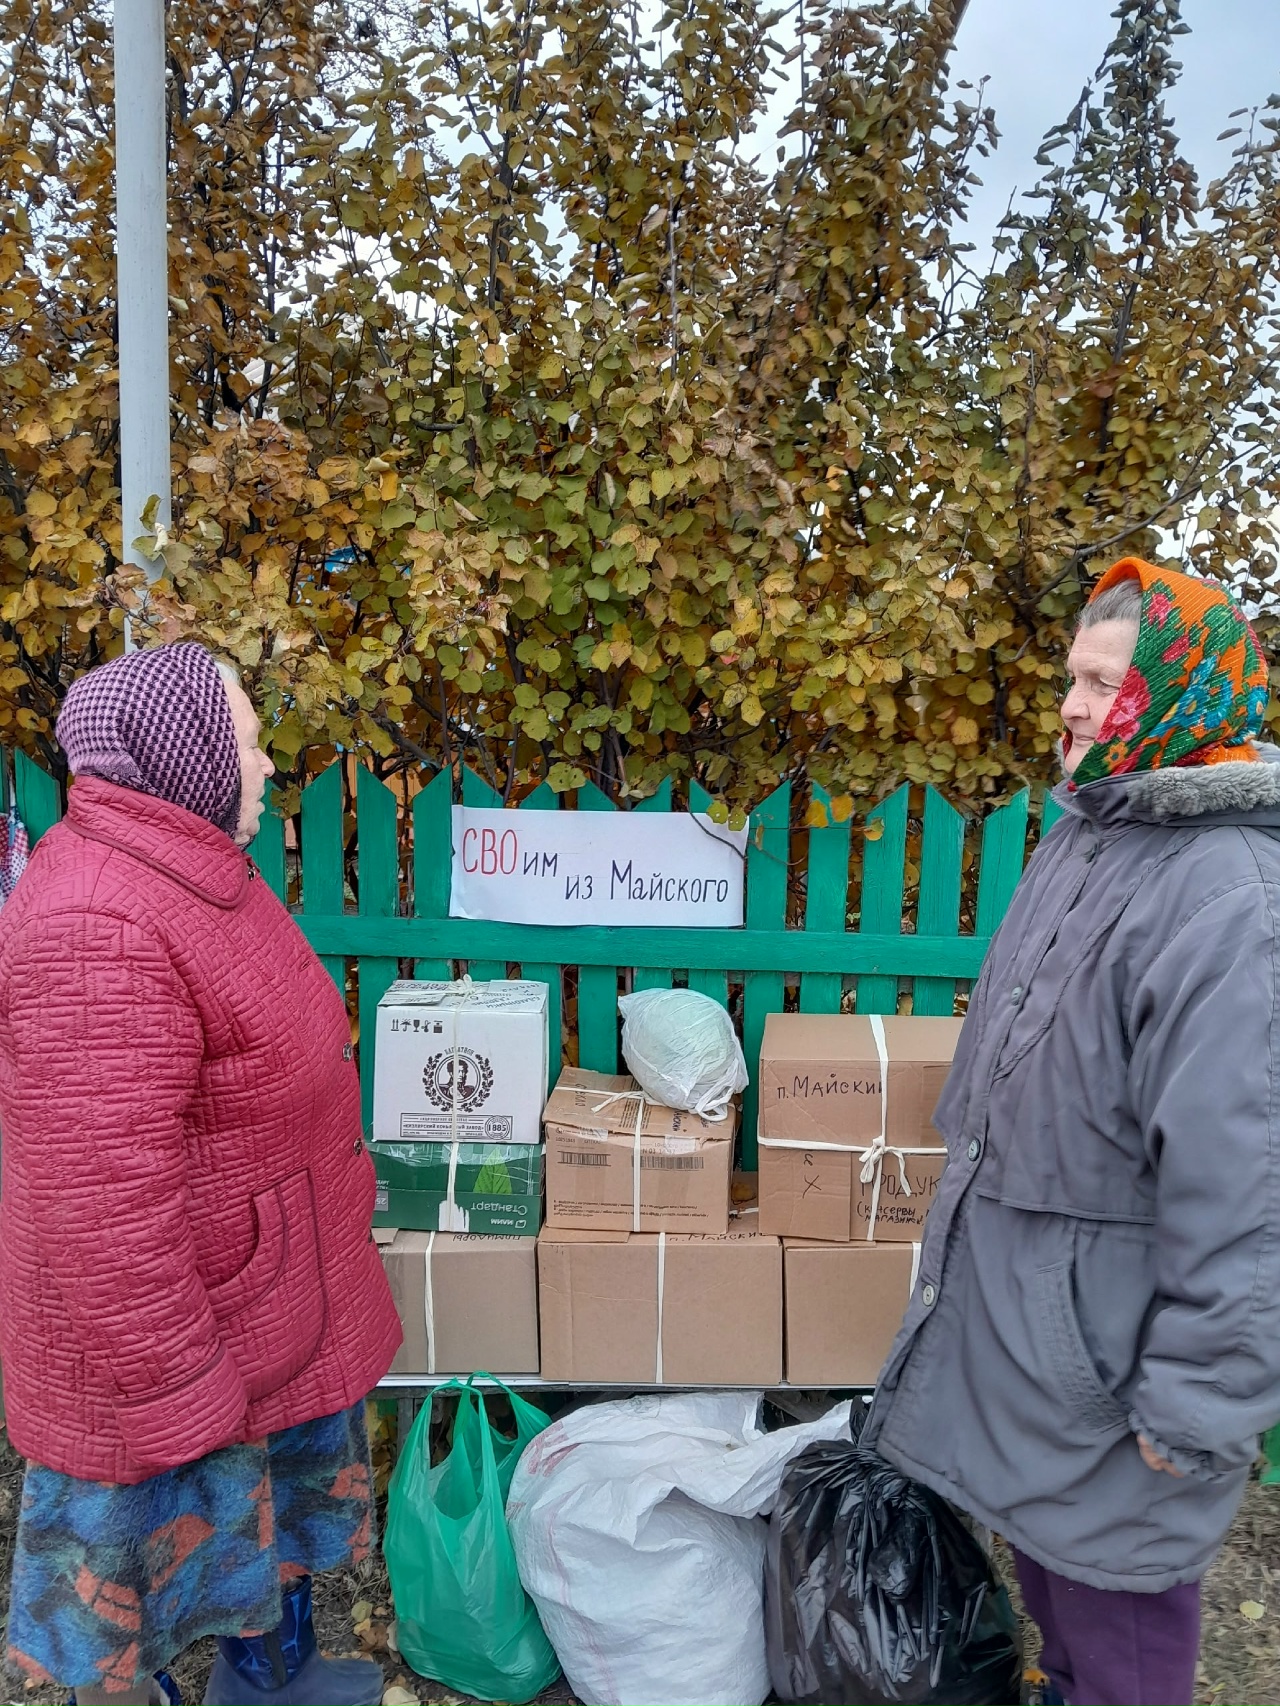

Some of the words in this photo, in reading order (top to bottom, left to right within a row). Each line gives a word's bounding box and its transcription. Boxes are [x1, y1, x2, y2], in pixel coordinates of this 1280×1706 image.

[462, 828, 558, 877] СВОим
[566, 874, 592, 900] из
[610, 859, 728, 903] Майского
[443, 1046, 475, 1056] БАГАТИОН
[793, 1073, 882, 1099] МАЙСКИ
[488, 1124, 507, 1132] 1885
[862, 1173, 941, 1200] РОДУК
[470, 1201, 528, 1216] Стандарт
